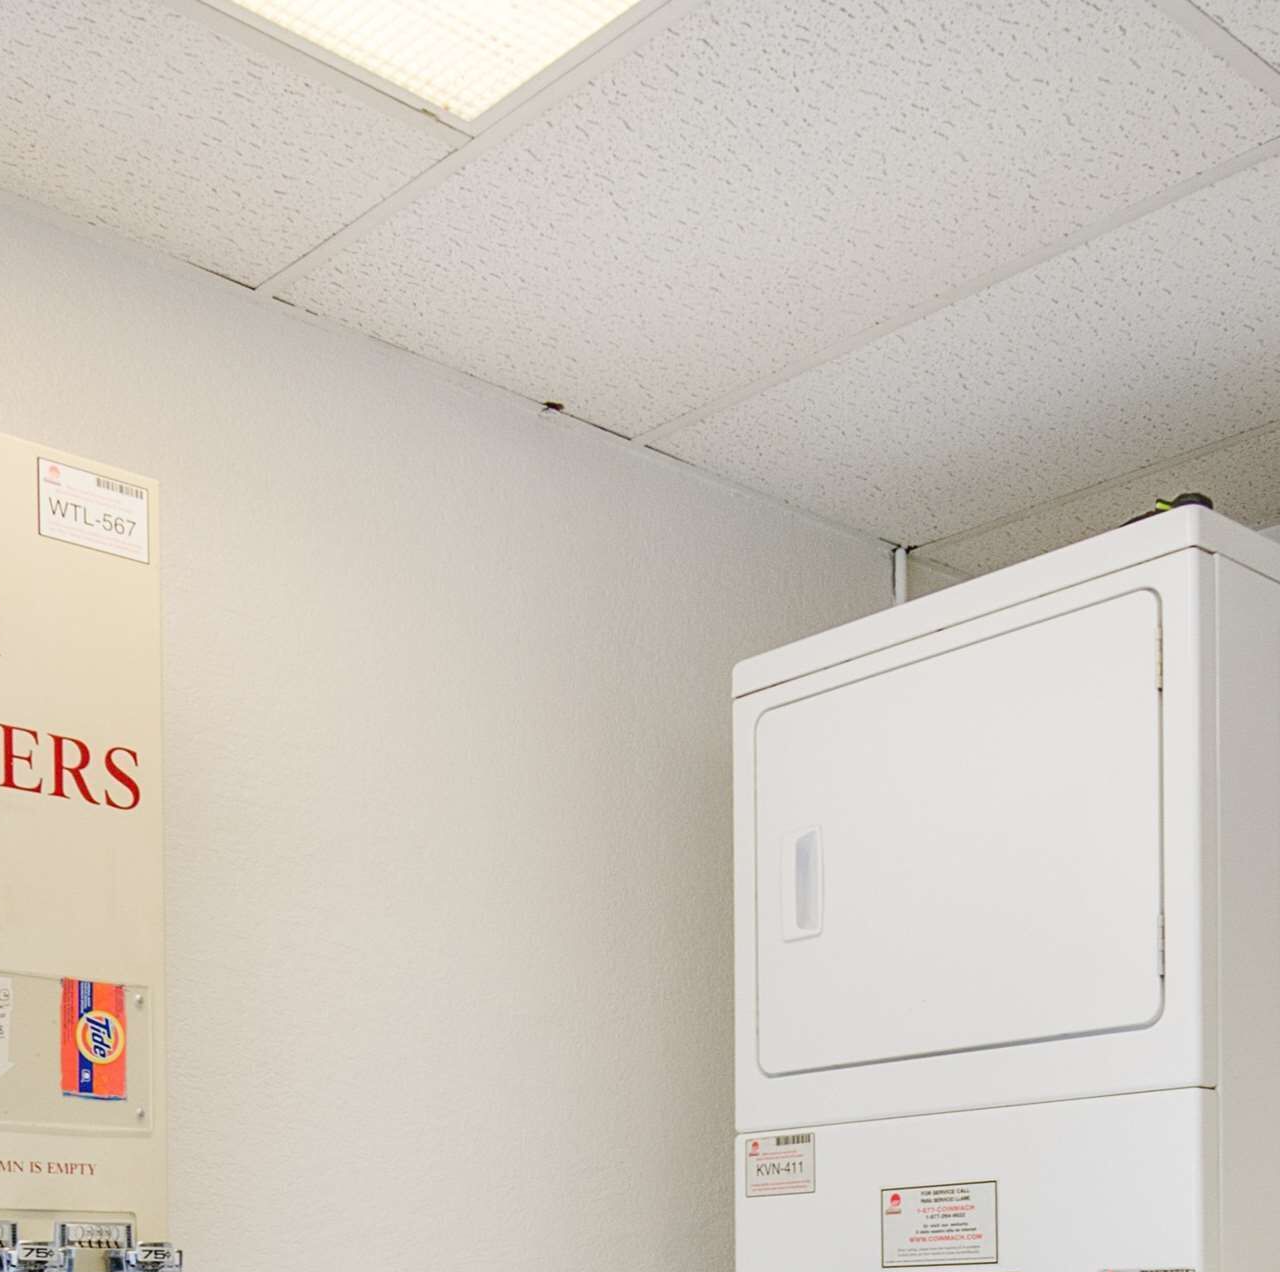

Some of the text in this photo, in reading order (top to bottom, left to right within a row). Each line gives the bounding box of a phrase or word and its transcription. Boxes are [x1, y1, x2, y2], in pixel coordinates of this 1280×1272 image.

[48, 496, 137, 537] WTL-567
[85, 1016, 113, 1059] Tide
[29, 1160, 42, 1174] IS
[47, 1161, 97, 1176] EMPTY
[756, 1161, 804, 1177] KVN-411
